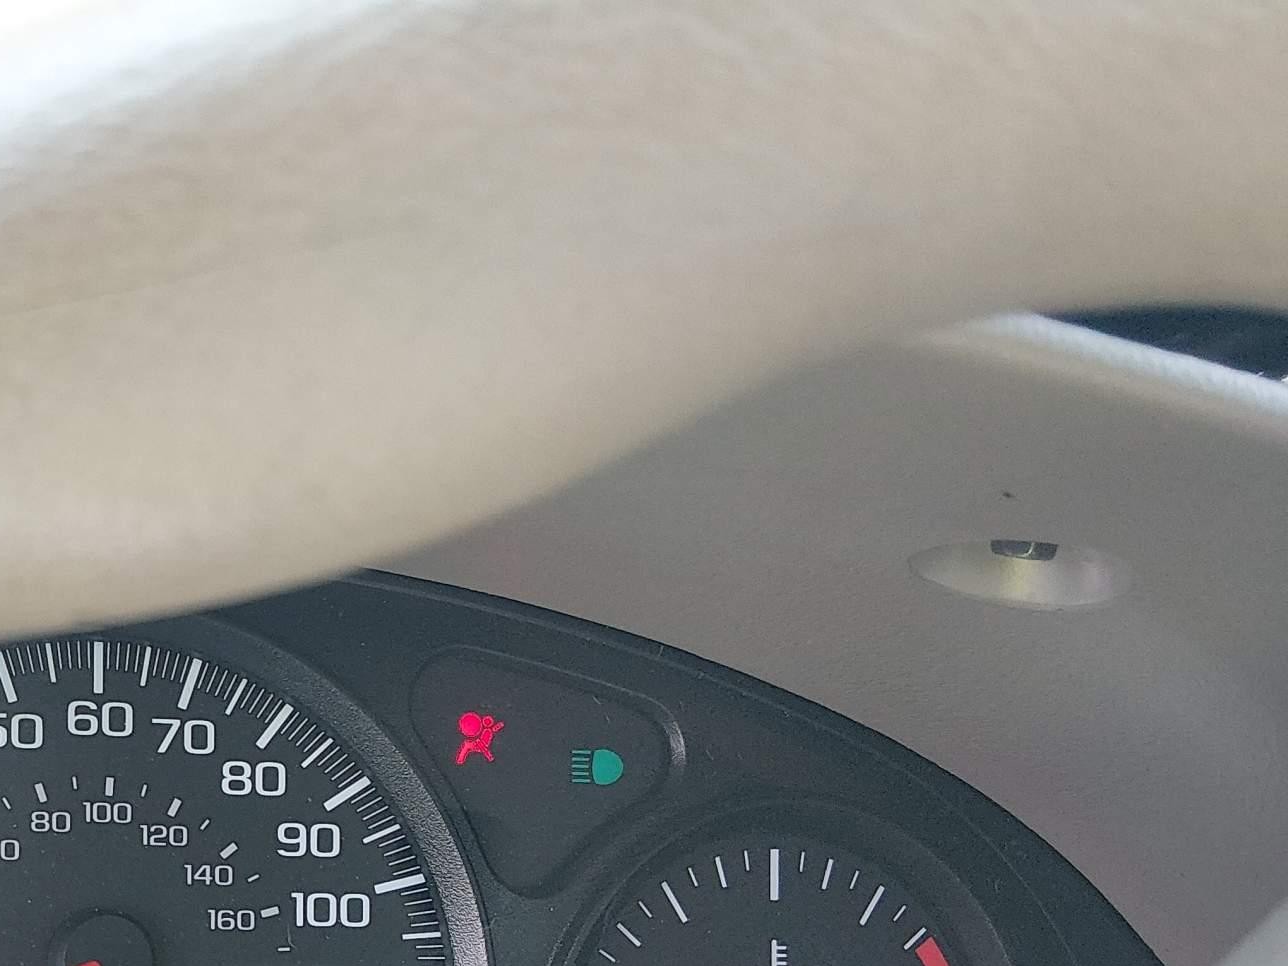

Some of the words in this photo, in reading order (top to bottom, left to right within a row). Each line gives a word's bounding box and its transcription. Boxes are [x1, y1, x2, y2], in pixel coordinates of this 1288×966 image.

[68, 701, 133, 736] 60
[152, 719, 214, 754] 70
[222, 761, 285, 796] 80
[31, 812, 70, 832] 80
[83, 802, 131, 823] 100
[140, 825, 187, 846] 120
[277, 823, 340, 857] 90
[184, 865, 232, 885] 140
[208, 910, 254, 930] 160
[291, 893, 369, 927] 100
